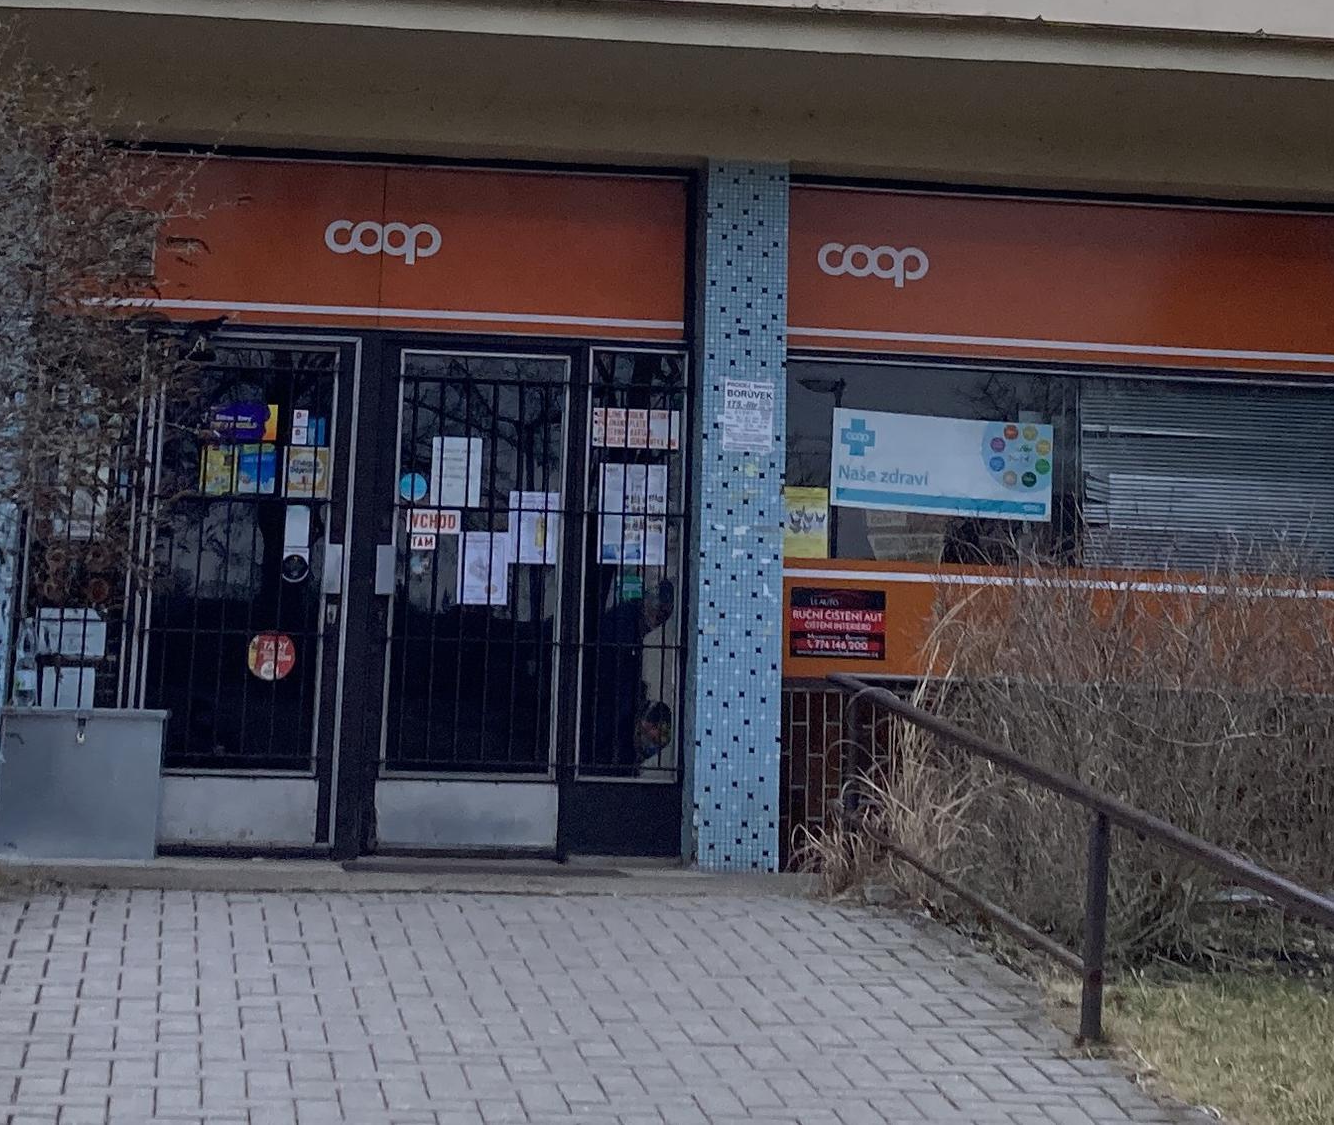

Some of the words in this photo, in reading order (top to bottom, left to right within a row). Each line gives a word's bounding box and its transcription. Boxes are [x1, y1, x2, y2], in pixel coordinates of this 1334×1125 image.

[325, 219, 442, 265] coop
[817, 242, 929, 287] coop
[839, 465, 876, 481] Naše
[412, 536, 433, 547] TAM
[792, 609, 823, 620] RUČNÍ
[825, 609, 863, 622] ČIŠTĚNÍ
[864, 612, 882, 622] AUT
